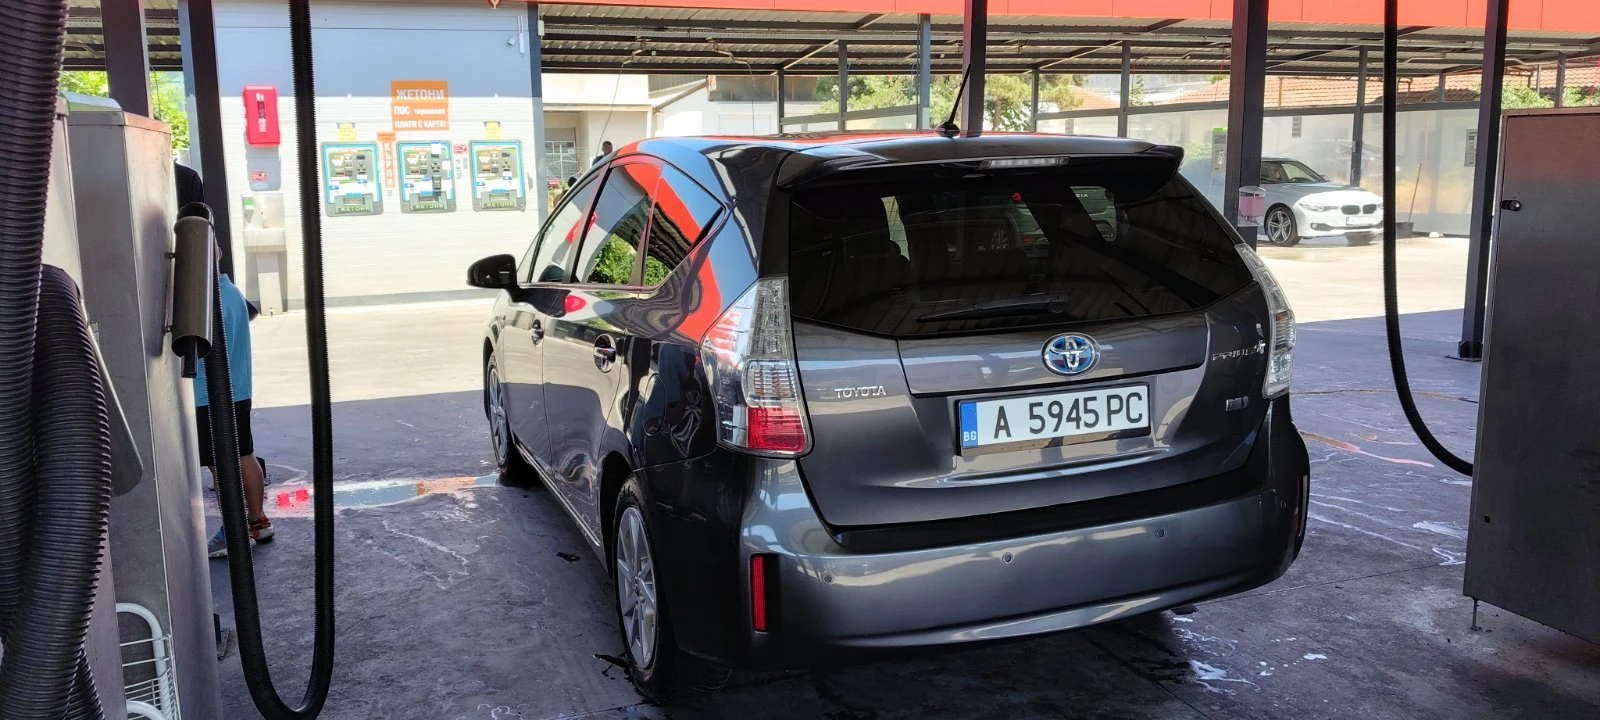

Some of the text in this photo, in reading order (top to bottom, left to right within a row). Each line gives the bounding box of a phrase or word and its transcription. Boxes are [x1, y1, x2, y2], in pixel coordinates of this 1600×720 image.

[395, 89, 444, 100] ЖЕТОНИ
[393, 106, 410, 115] ПОС
[834, 385, 886, 398] TOYOTA
[993, 391, 1143, 439] A 5945 PC
[963, 430, 977, 442] BG
